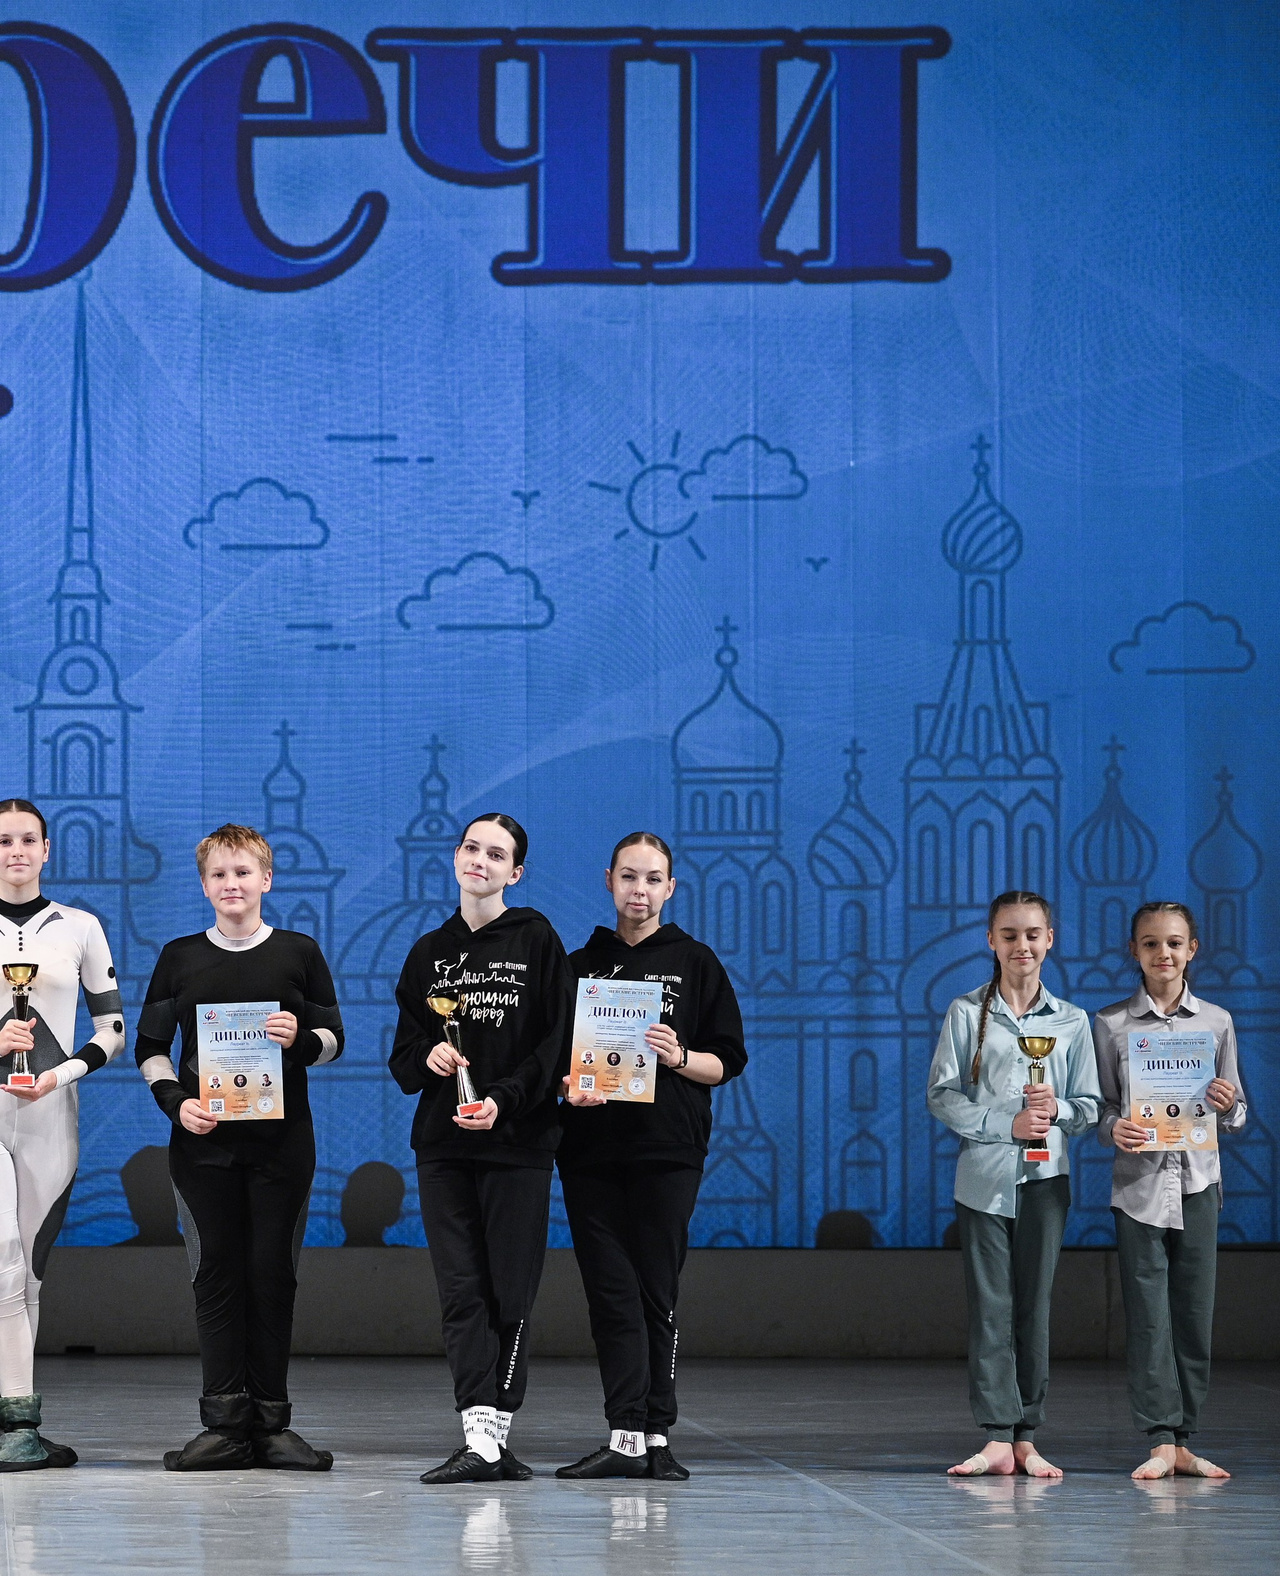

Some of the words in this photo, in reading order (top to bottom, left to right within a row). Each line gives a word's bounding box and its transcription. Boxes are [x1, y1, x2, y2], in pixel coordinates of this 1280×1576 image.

[469, 1006, 505, 1027] город
[588, 1006, 647, 1019] ДИПЛОМ
[210, 1030, 268, 1043] ДИПЛОМ
[1142, 1059, 1201, 1072] ДИПЛОМ
